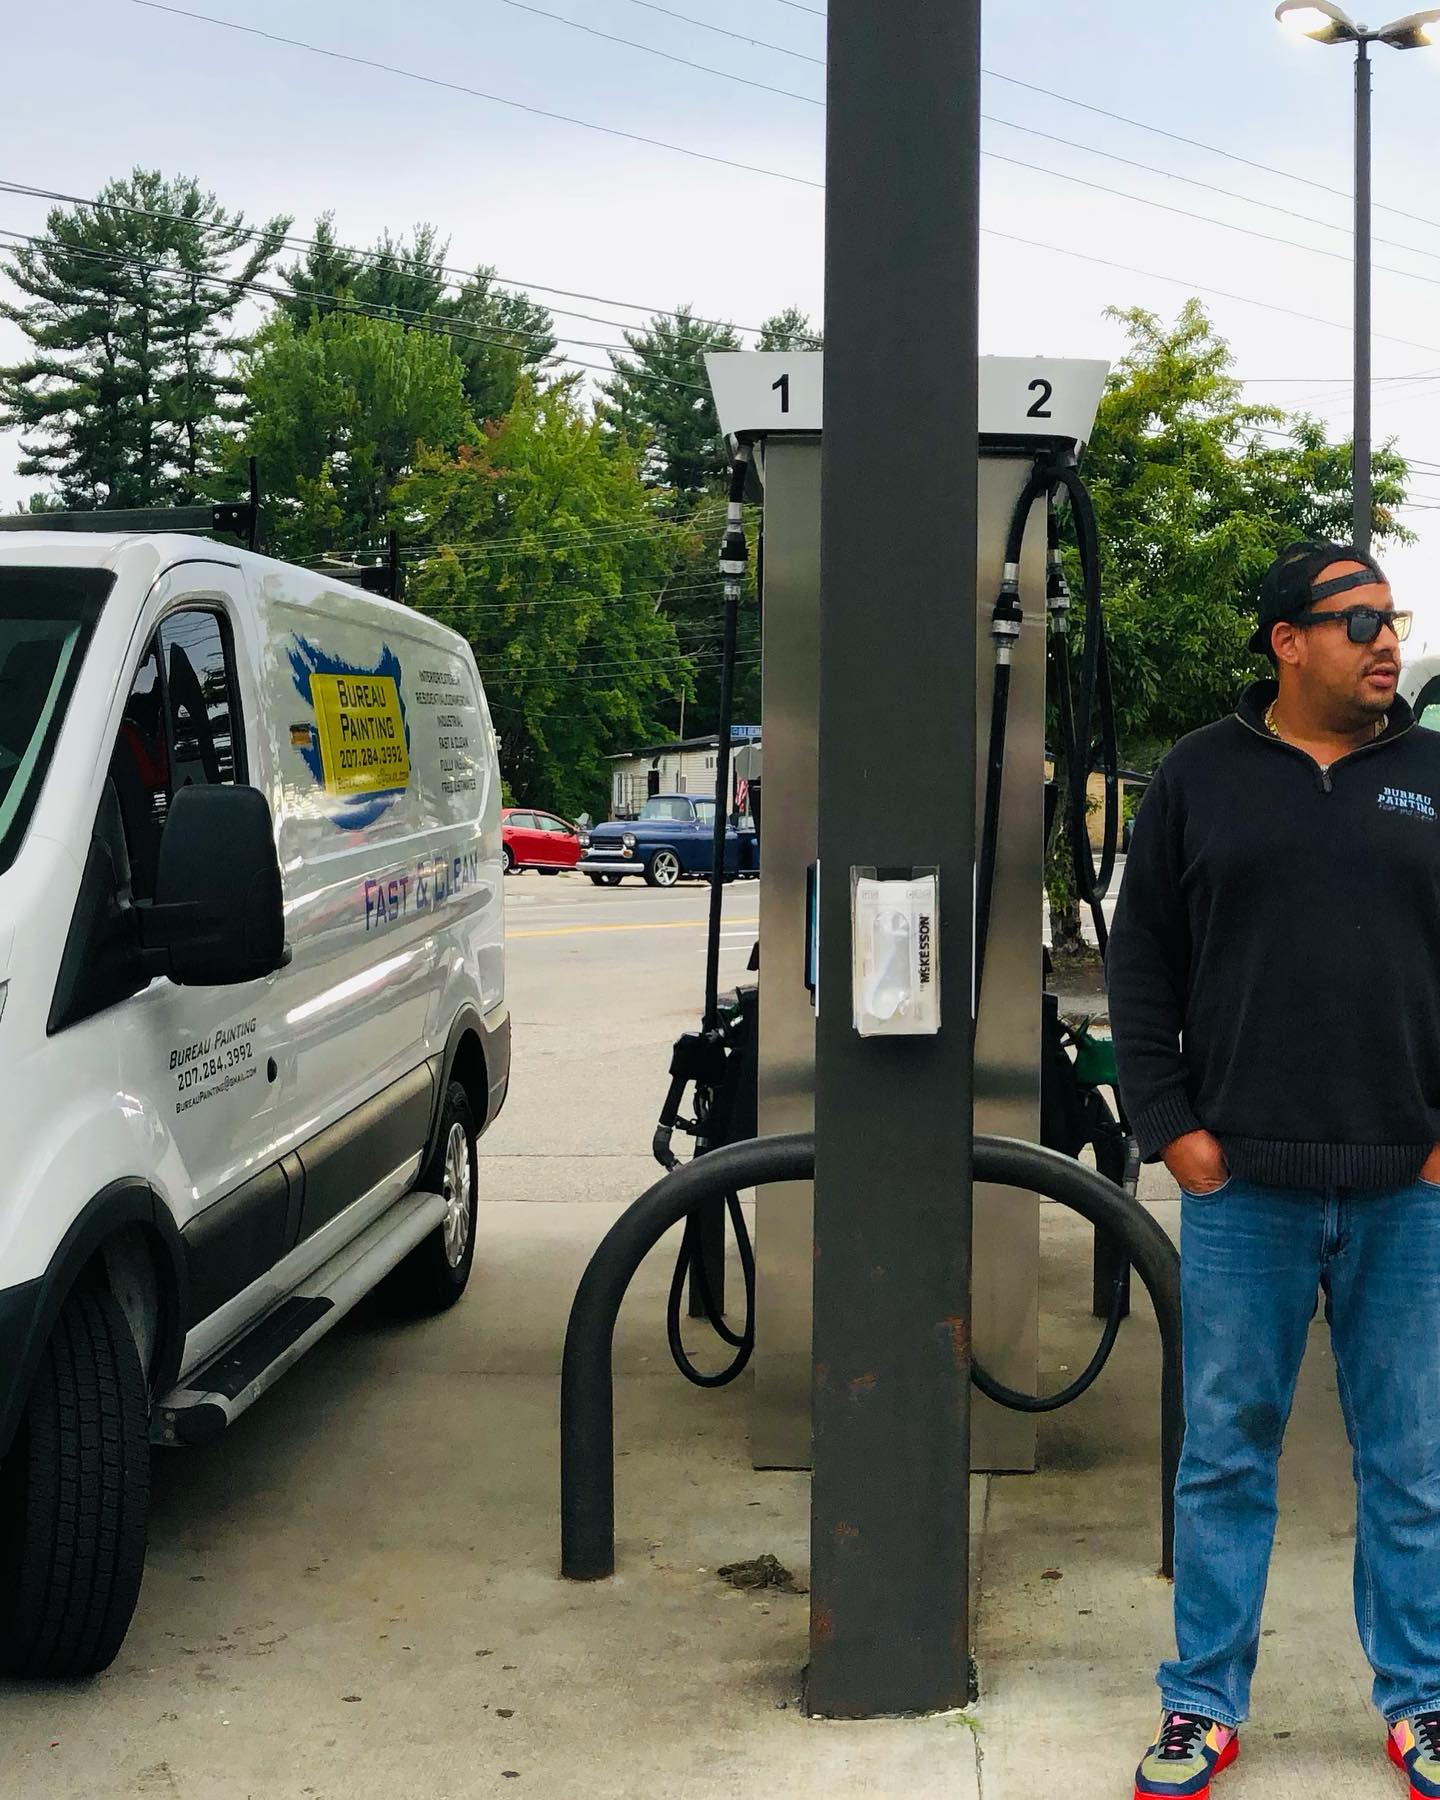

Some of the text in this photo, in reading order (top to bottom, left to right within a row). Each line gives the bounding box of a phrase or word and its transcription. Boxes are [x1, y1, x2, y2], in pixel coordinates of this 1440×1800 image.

[771, 373, 790, 414] 1
[1026, 378, 1053, 419] 2
[337, 680, 387, 709] BUREAU
[340, 713, 395, 742] PAINTING
[339, 746, 403, 769] 207.284.3992
[1377, 793, 1436, 817] PAINTING
[1383, 786, 1432, 806] BUREAU
[364, 877, 409, 931] FAST
[169, 1017, 257, 1071] BUREAU PAINTING
[177, 1042, 253, 1092] 207.284.3992
